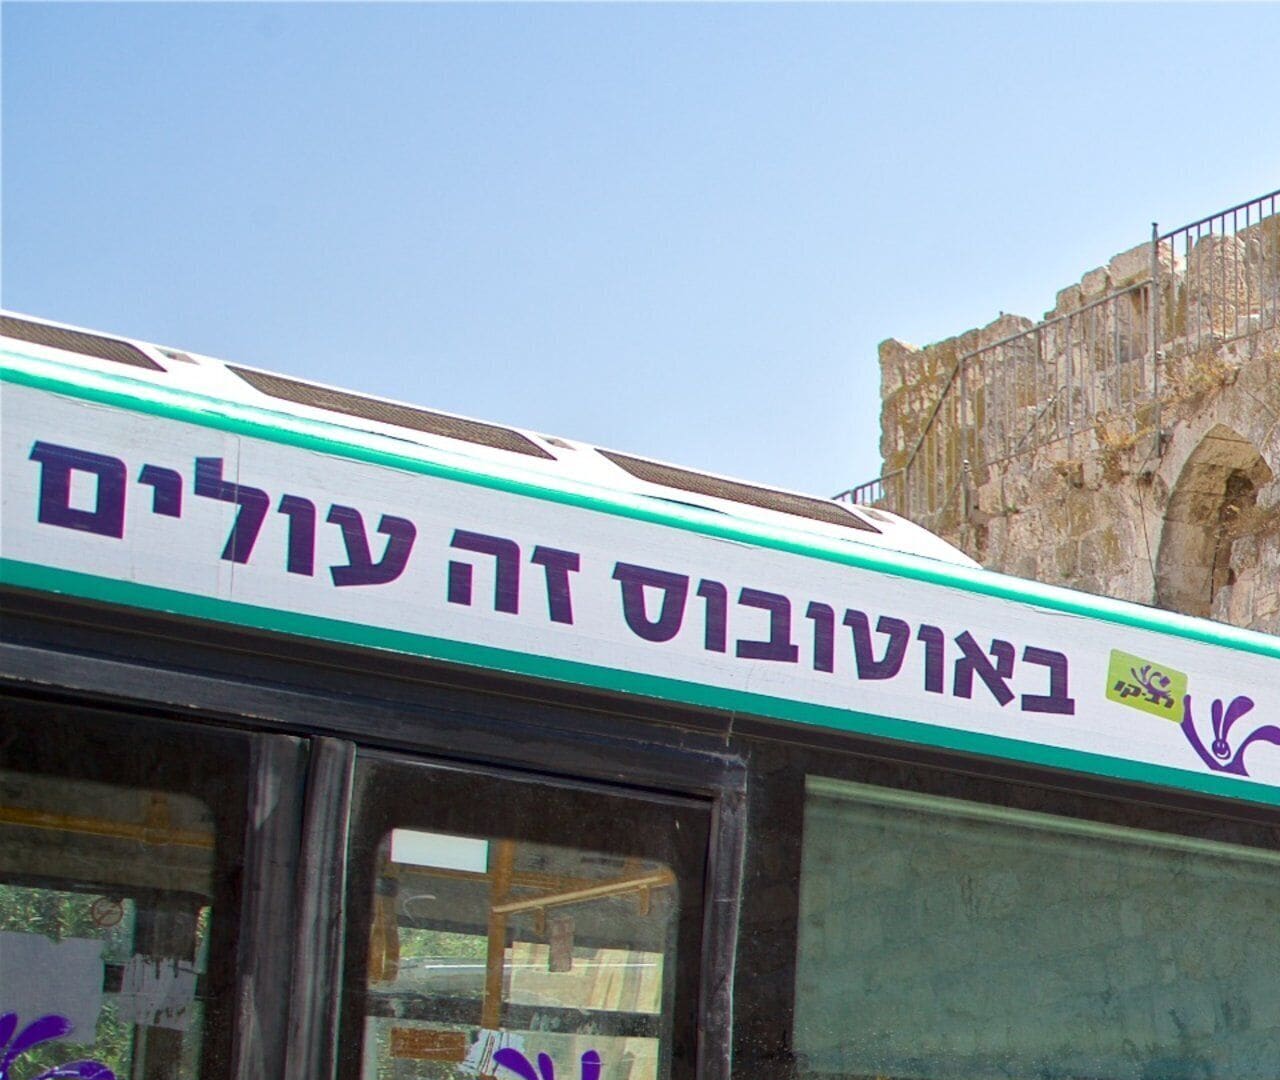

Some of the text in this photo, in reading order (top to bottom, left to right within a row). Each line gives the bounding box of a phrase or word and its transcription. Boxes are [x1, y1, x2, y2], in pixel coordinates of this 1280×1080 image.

[28, 440, 1075, 716] באוטובוס זה עולים
